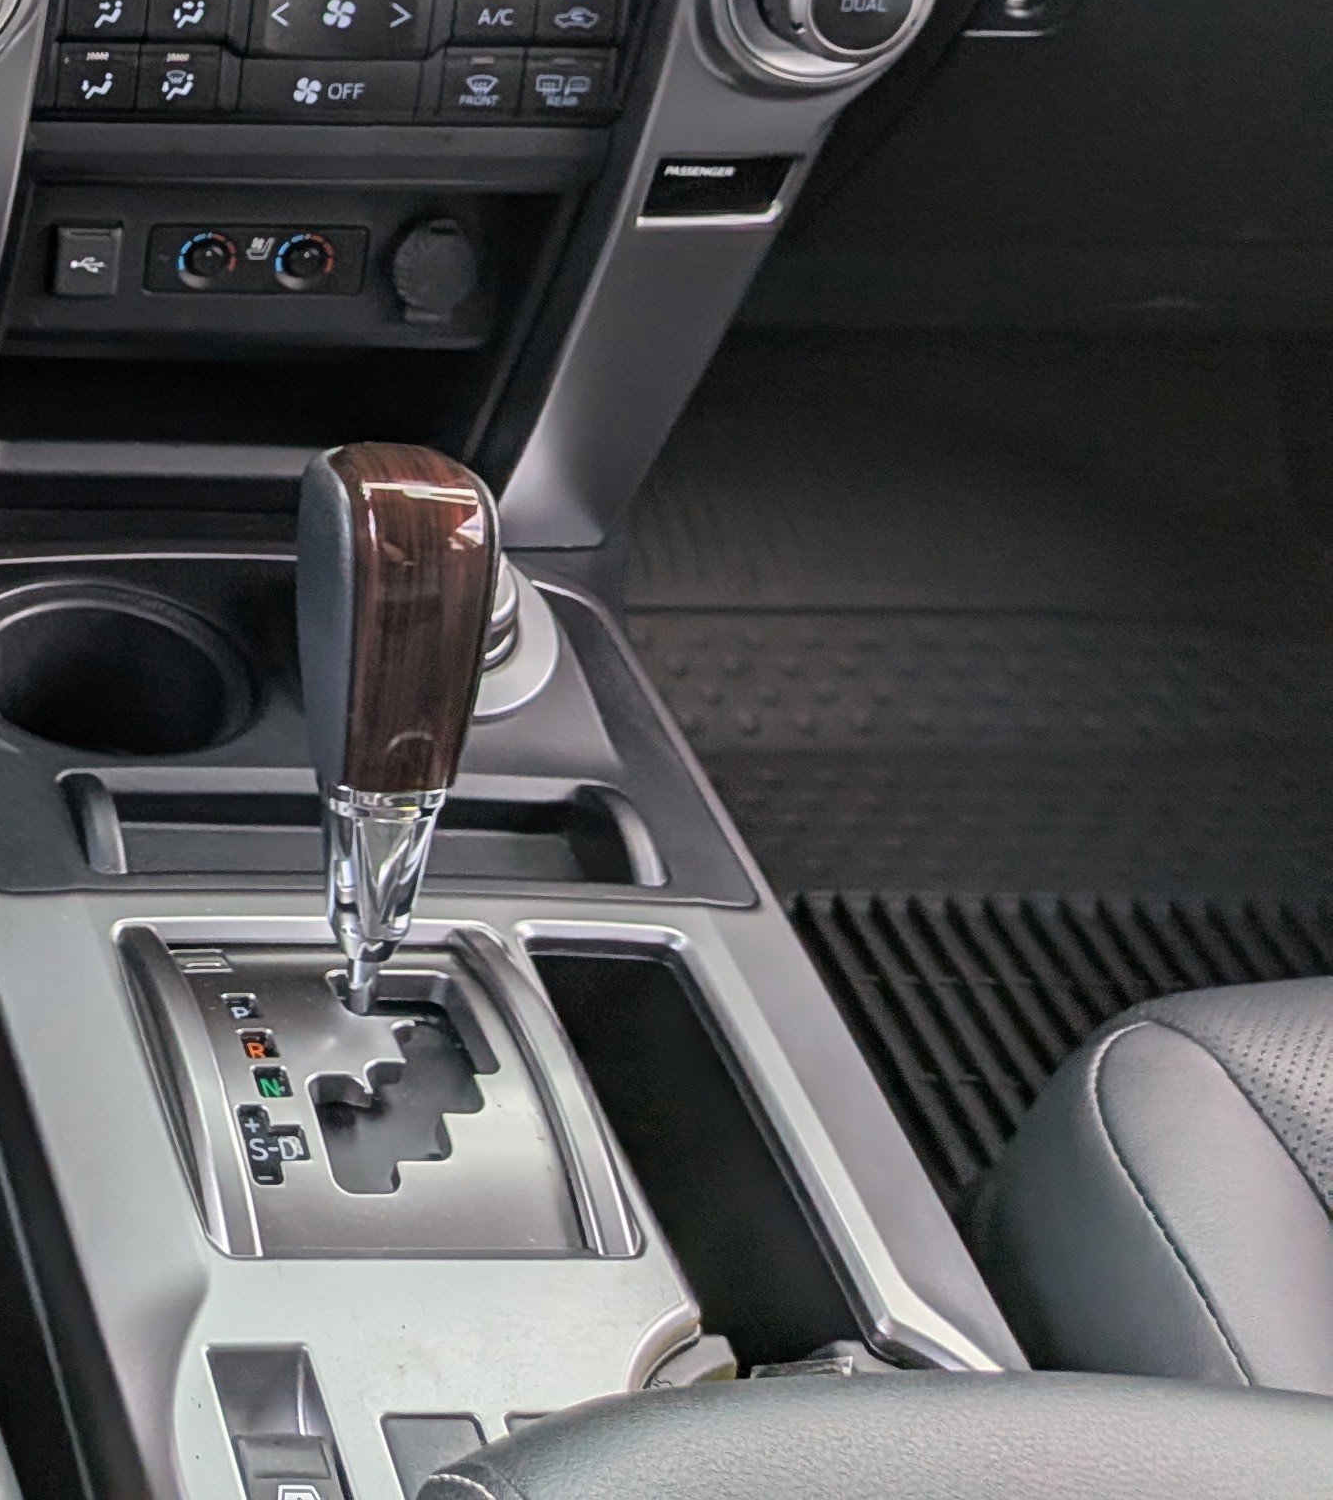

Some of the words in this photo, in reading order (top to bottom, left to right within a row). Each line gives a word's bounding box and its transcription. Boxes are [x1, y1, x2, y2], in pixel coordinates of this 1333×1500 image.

[477, 8, 515, 26] A/C
[328, 82, 366, 100] OFF
[231, 1006, 250, 1019] P
[247, 1042, 266, 1058] R
[259, 1078, 282, 1098] N
